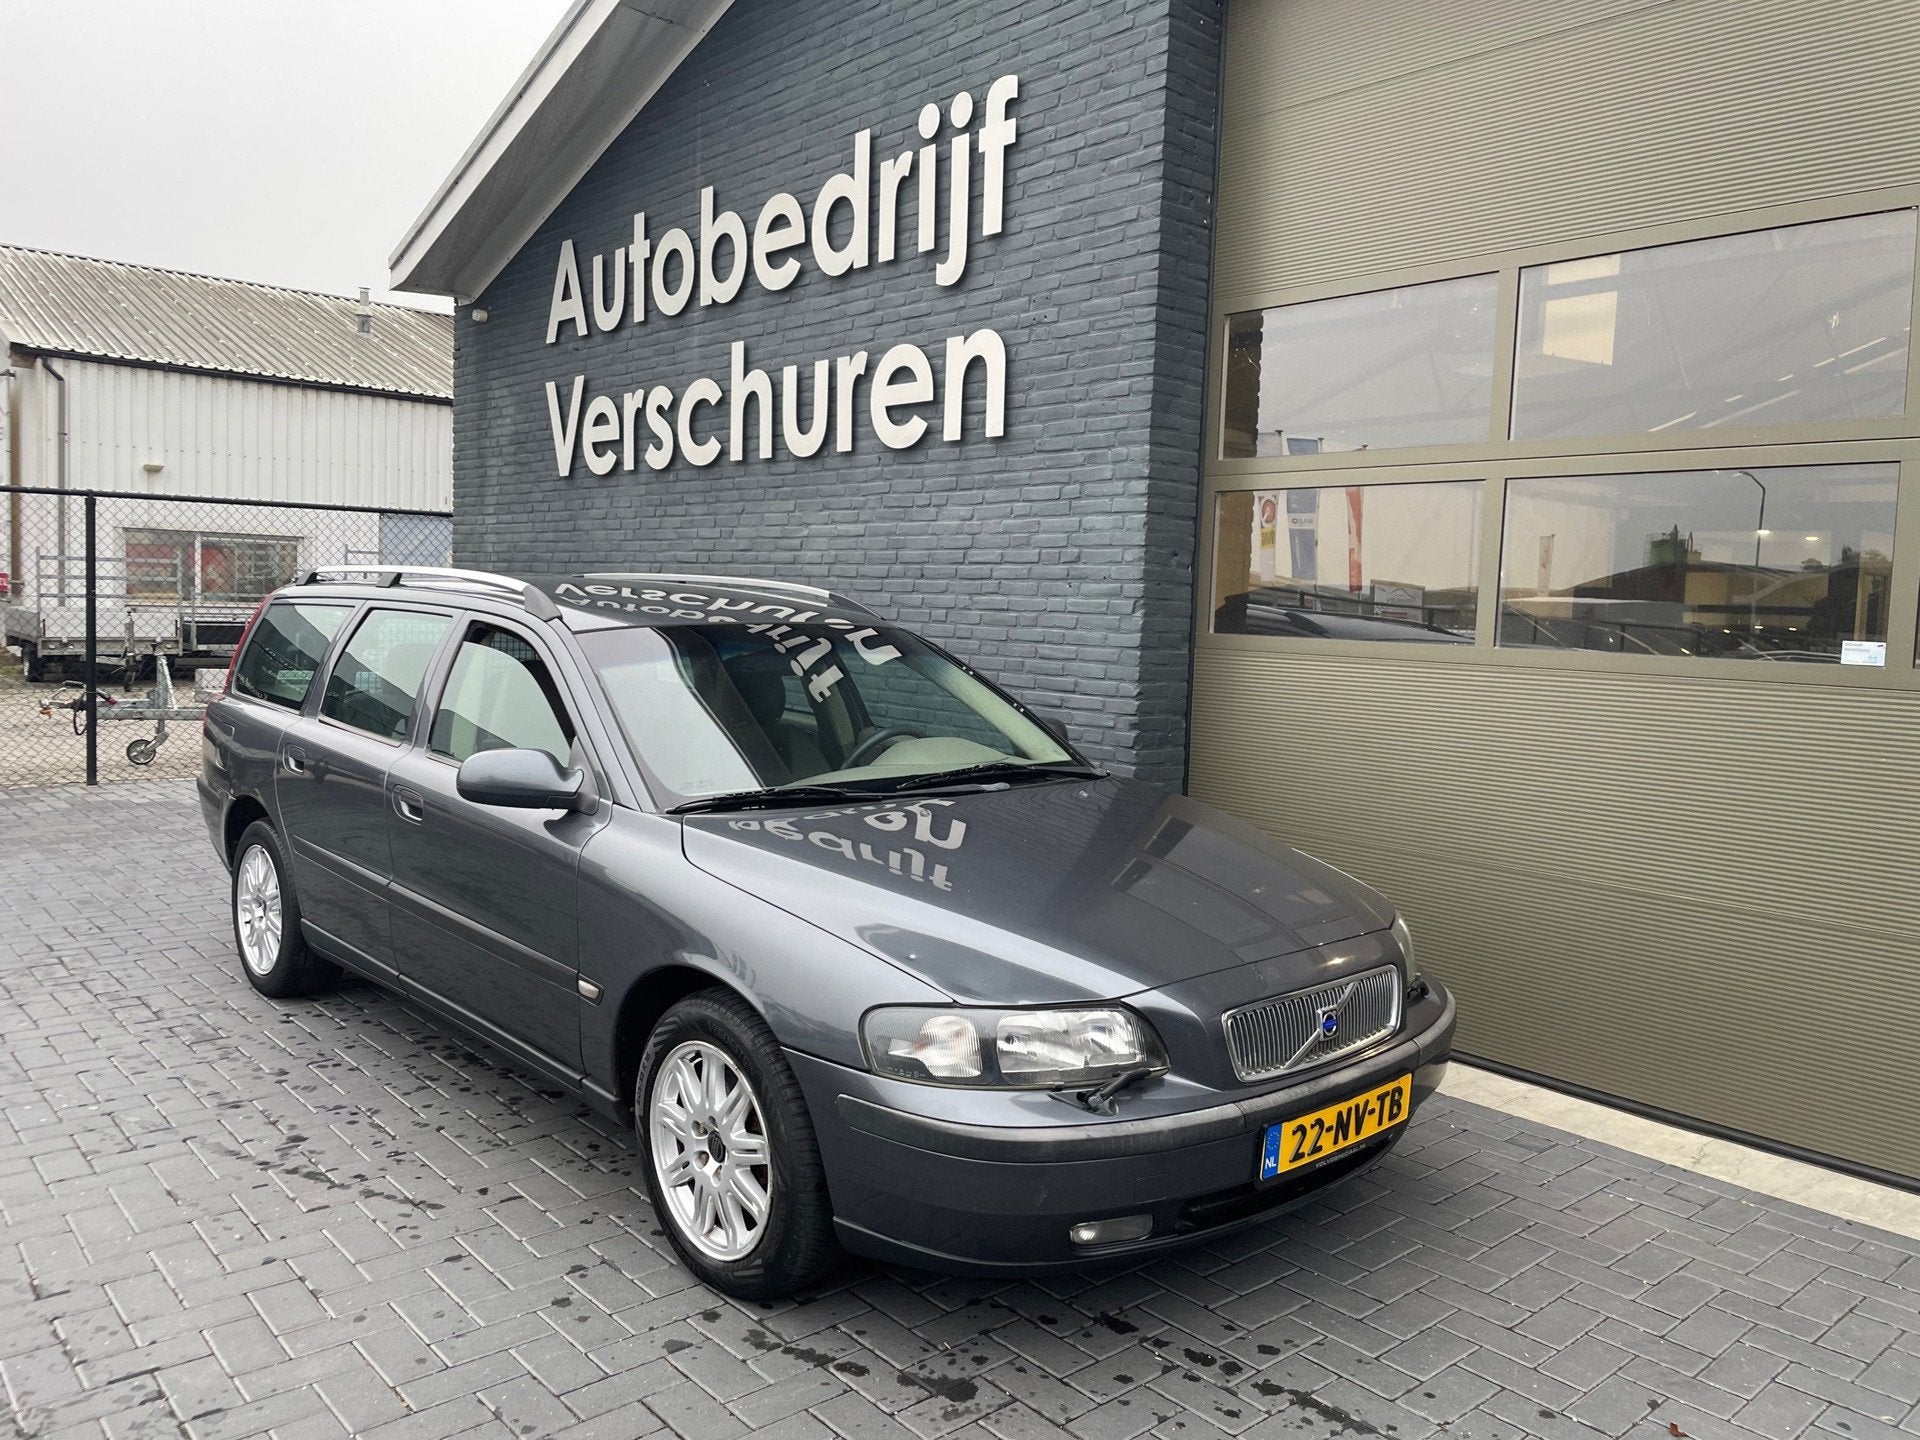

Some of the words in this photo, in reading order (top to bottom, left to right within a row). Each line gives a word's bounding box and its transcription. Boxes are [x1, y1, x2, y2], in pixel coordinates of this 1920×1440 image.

[546, 75, 1018, 343] Autobedrijf
[546, 328, 1006, 476] Verschuren
[1265, 1156, 1277, 1169] NL
[1289, 1086, 1403, 1163] 22-NV-TB
